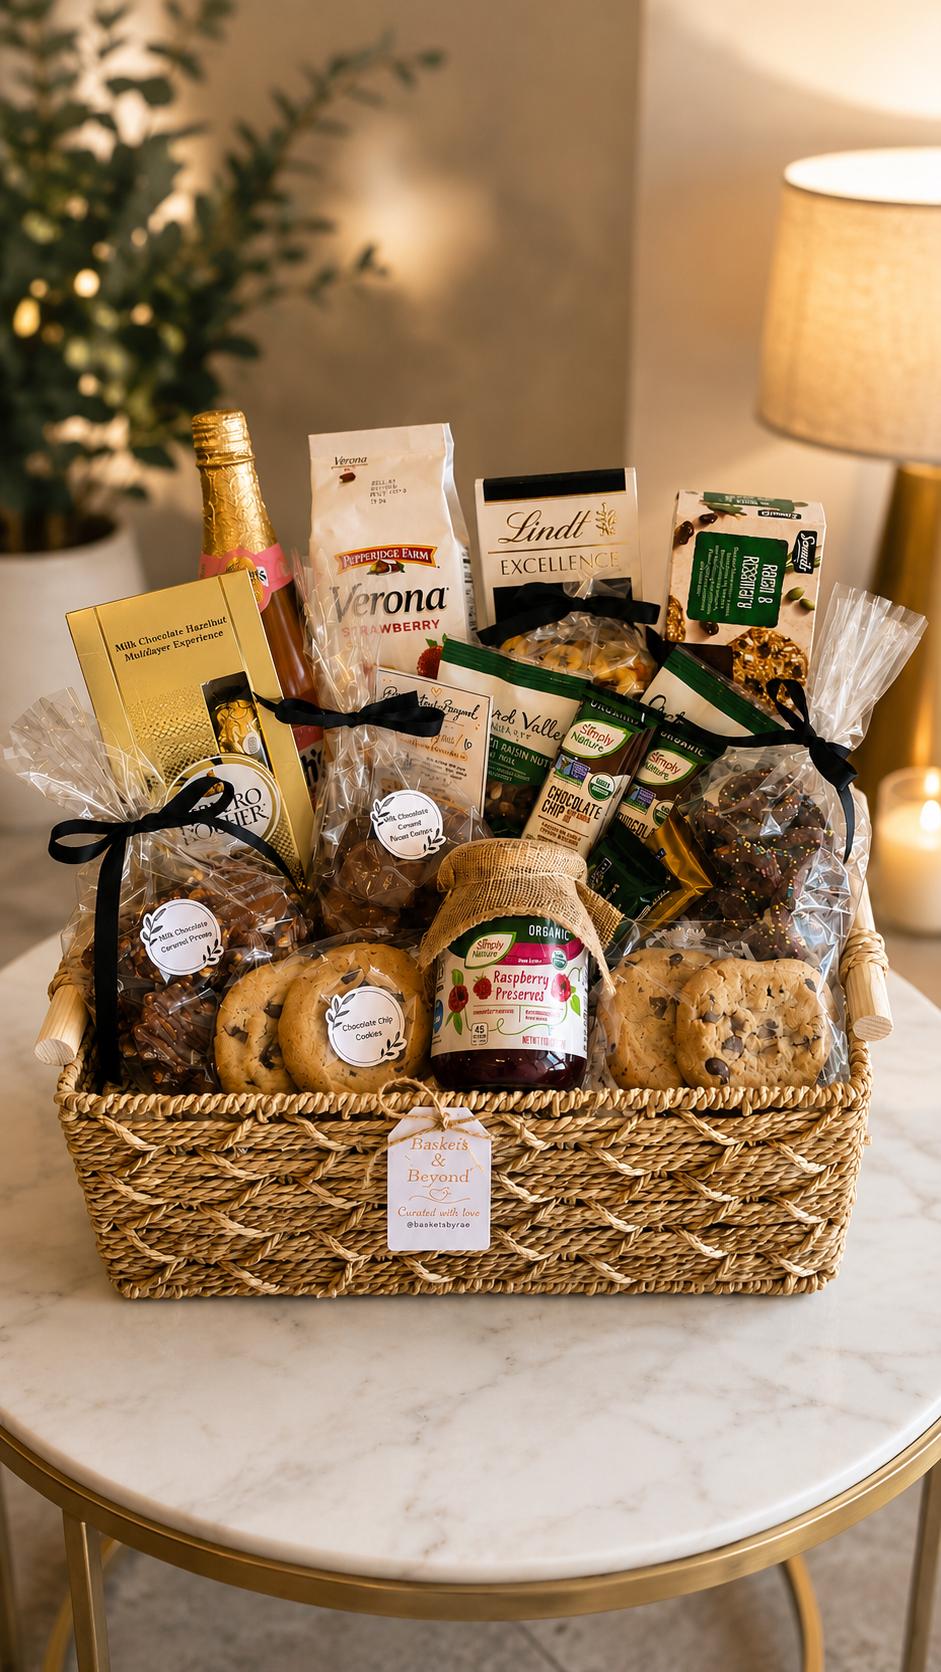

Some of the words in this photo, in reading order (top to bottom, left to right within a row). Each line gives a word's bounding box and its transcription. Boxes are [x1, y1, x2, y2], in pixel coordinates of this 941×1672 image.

[335, 456, 367, 465] Verona
[498, 509, 591, 544] Lindt
[343, 549, 400, 568] PEPPERIDGE
[402, 548, 429, 560] FARM
[501, 552, 620, 576] EXCELLENCE
[329, 583, 447, 623] Verona
[342, 619, 440, 637] STRAWBERRY
[115, 641, 137, 652] Milk
[138, 629, 184, 646] Chocolate
[173, 630, 224, 649] Experience
[522, 711, 565, 740] Valle
[501, 743, 529, 760] RAISIN
[541, 799, 565, 818] CHIP
[547, 785, 603, 820] CHOCOLATE
[158, 932, 174, 942] Milk
[529, 924, 571, 941] ORGANIC
[493, 970, 549, 990] Raspberry
[496, 987, 544, 1001] Preserves
[342, 1020, 377, 1032] Chocolate
[378, 1016, 393, 1025] Chip
[355, 1030, 383, 1040] Cookies
[431, 1153, 446, 1167] &
[408, 1168, 470, 1187] Beyond
[397, 1206, 436, 1217] Curated
[439, 1207, 458, 1217] with
[462, 1207, 480, 1217] love
